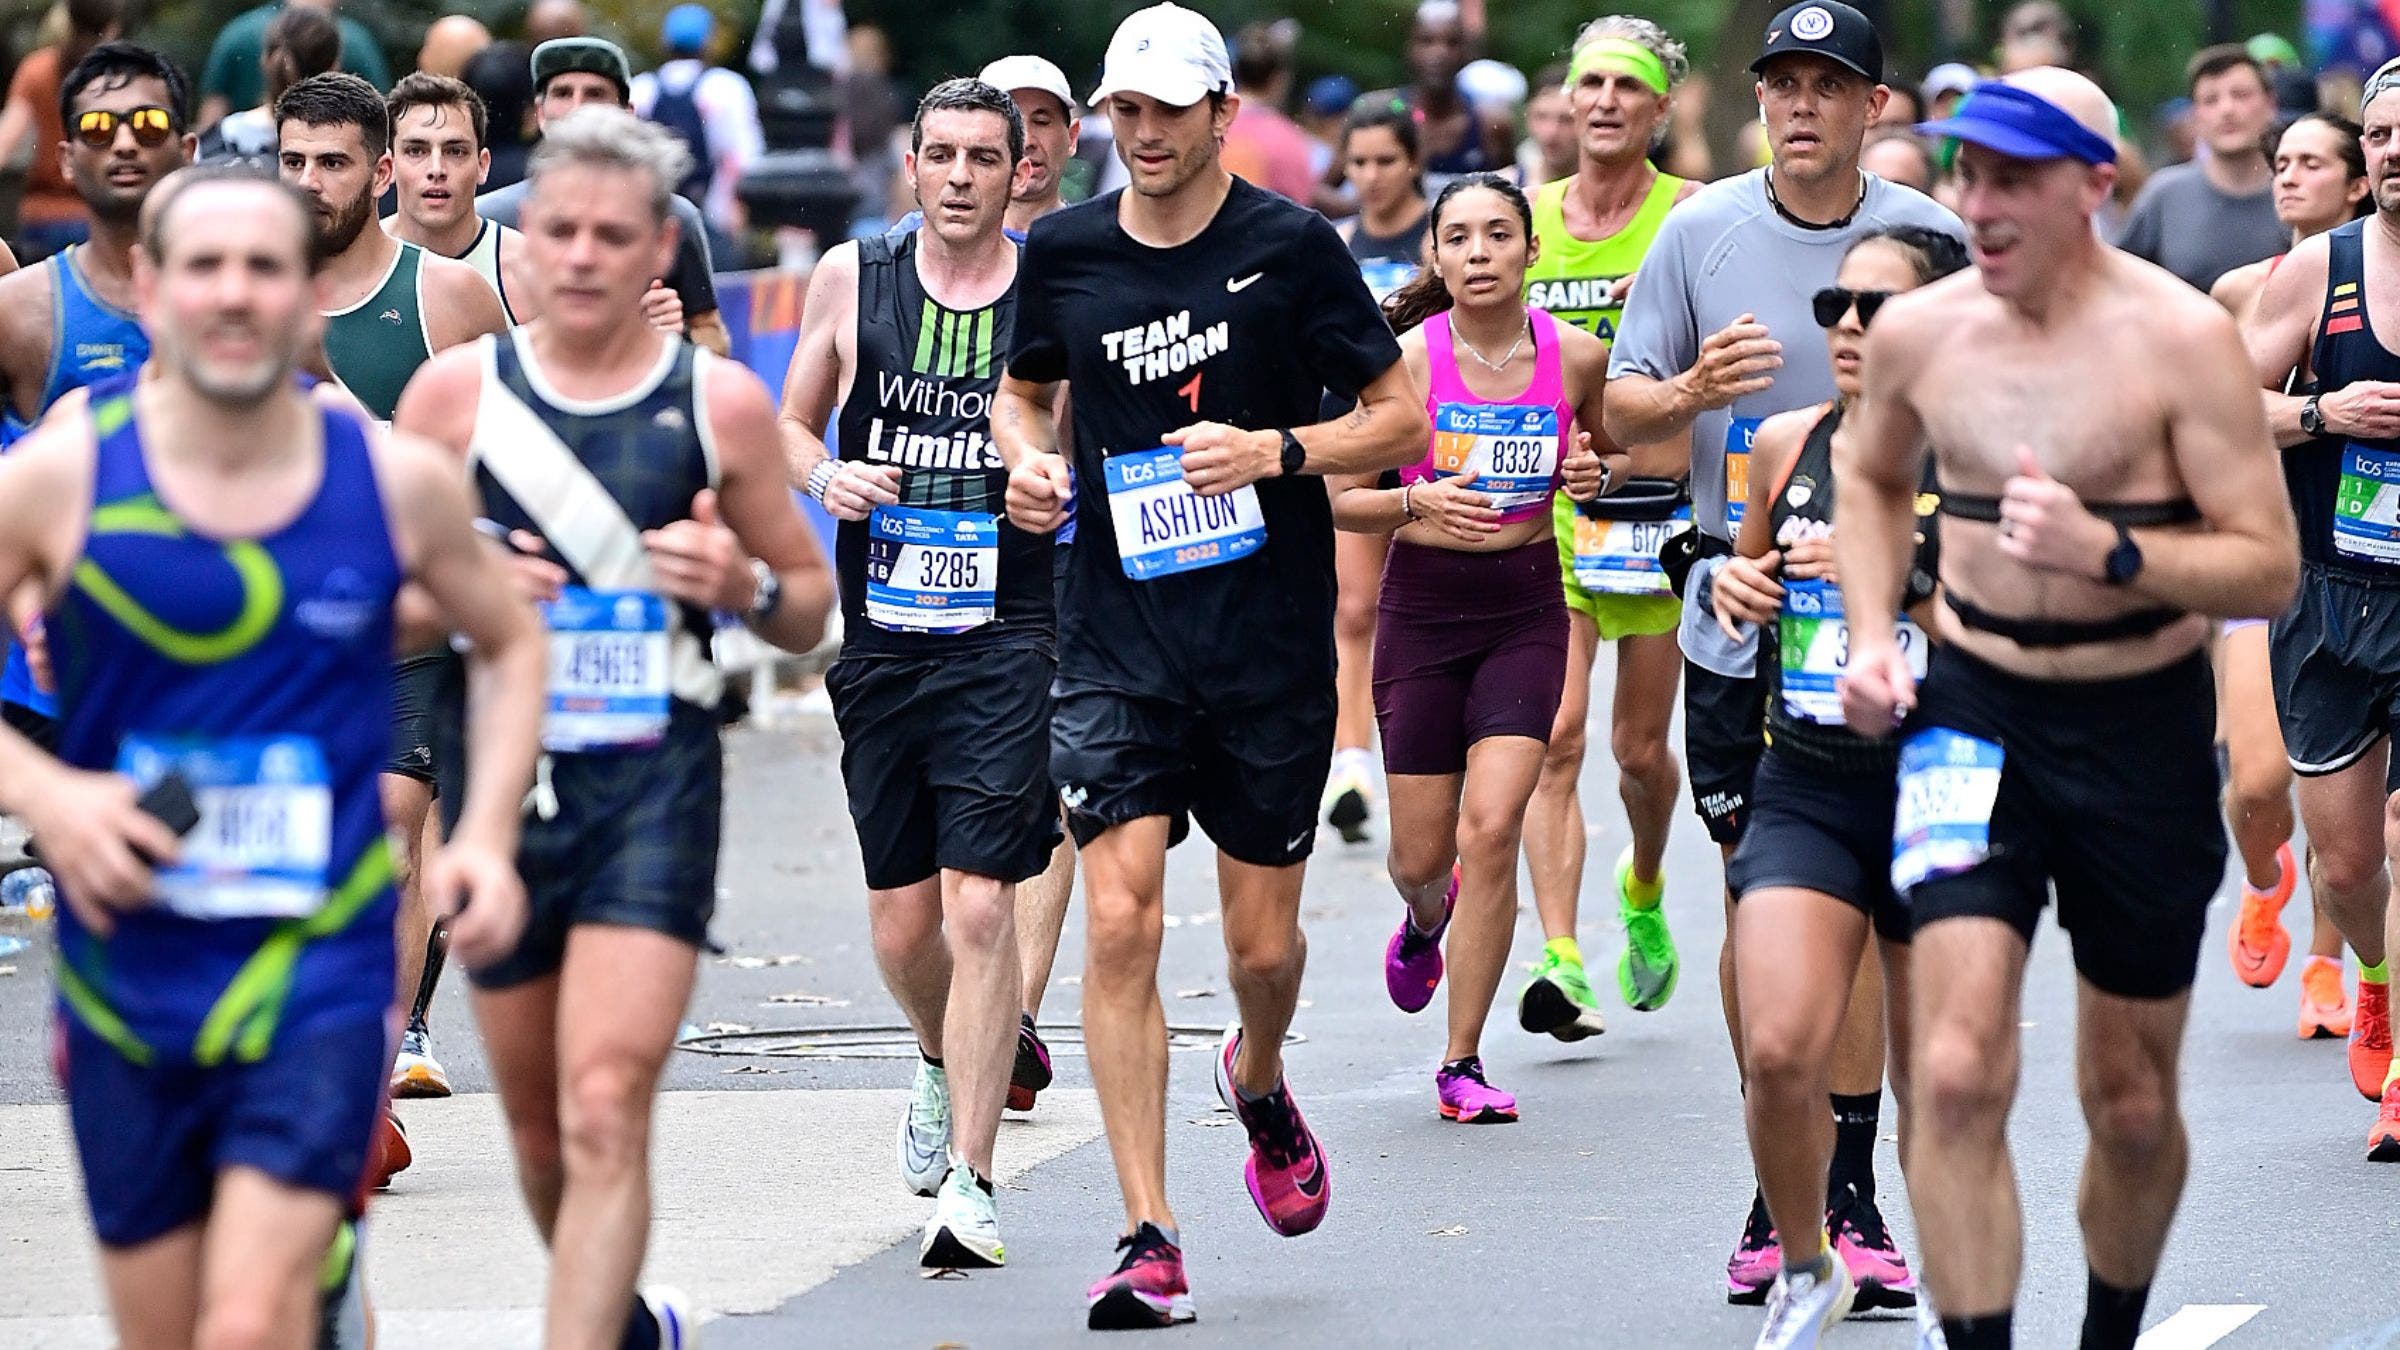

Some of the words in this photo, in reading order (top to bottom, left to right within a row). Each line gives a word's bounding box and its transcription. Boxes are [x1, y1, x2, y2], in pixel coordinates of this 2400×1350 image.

[1528, 278, 1625, 309] SAND
[1101, 310, 1190, 362] TEAM
[1123, 321, 1228, 386] THORN
[1450, 410, 1477, 428] tcs
[1492, 440, 1542, 474] 8332
[2355, 454, 2382, 476] tcs
[1120, 462, 1155, 485] tcs
[1140, 490, 1238, 545] ASHTON
[2350, 500, 2363, 513] D
[881, 513, 904, 536] tcs
[954, 533, 979, 542] TATA
[1174, 541, 1220, 564] 2022
[878, 564, 889, 579] B
[920, 550, 978, 588] 3285
[914, 594, 948, 607] 2022
